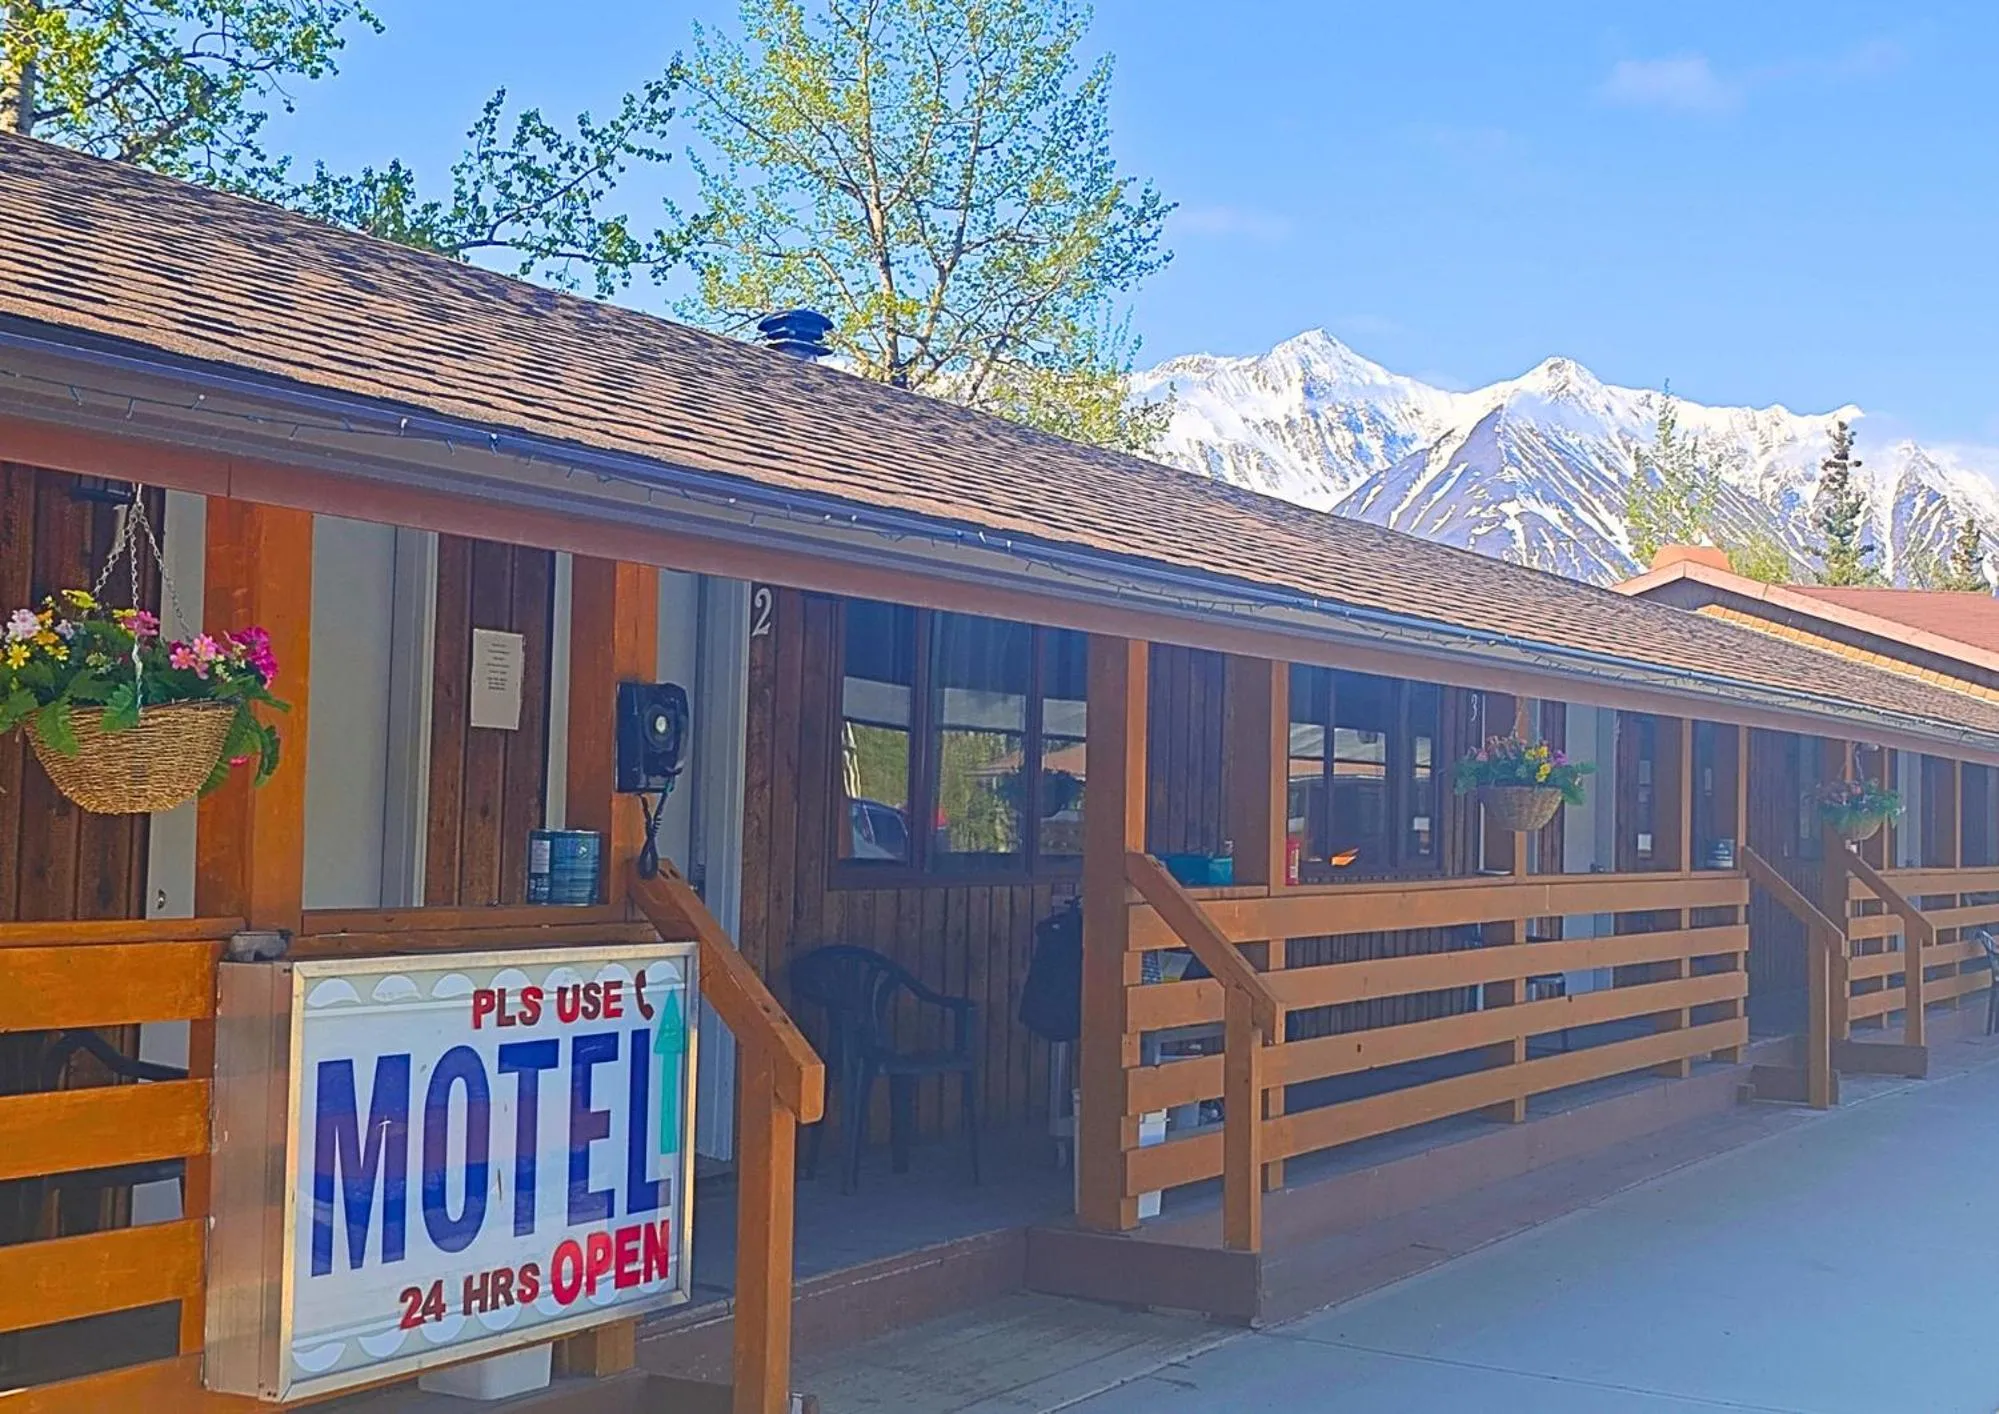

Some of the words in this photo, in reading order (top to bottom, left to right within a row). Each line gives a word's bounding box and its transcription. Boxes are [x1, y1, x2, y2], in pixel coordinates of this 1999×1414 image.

[752, 588, 771, 637] 2
[1470, 693, 1478, 722] 3
[472, 986, 544, 1030] PLS
[557, 980, 624, 1024] USE
[311, 1028, 671, 1277] MOTEL
[400, 1279, 446, 1330] 24
[462, 1262, 541, 1316] HRS
[551, 1219, 670, 1306] OPEN
